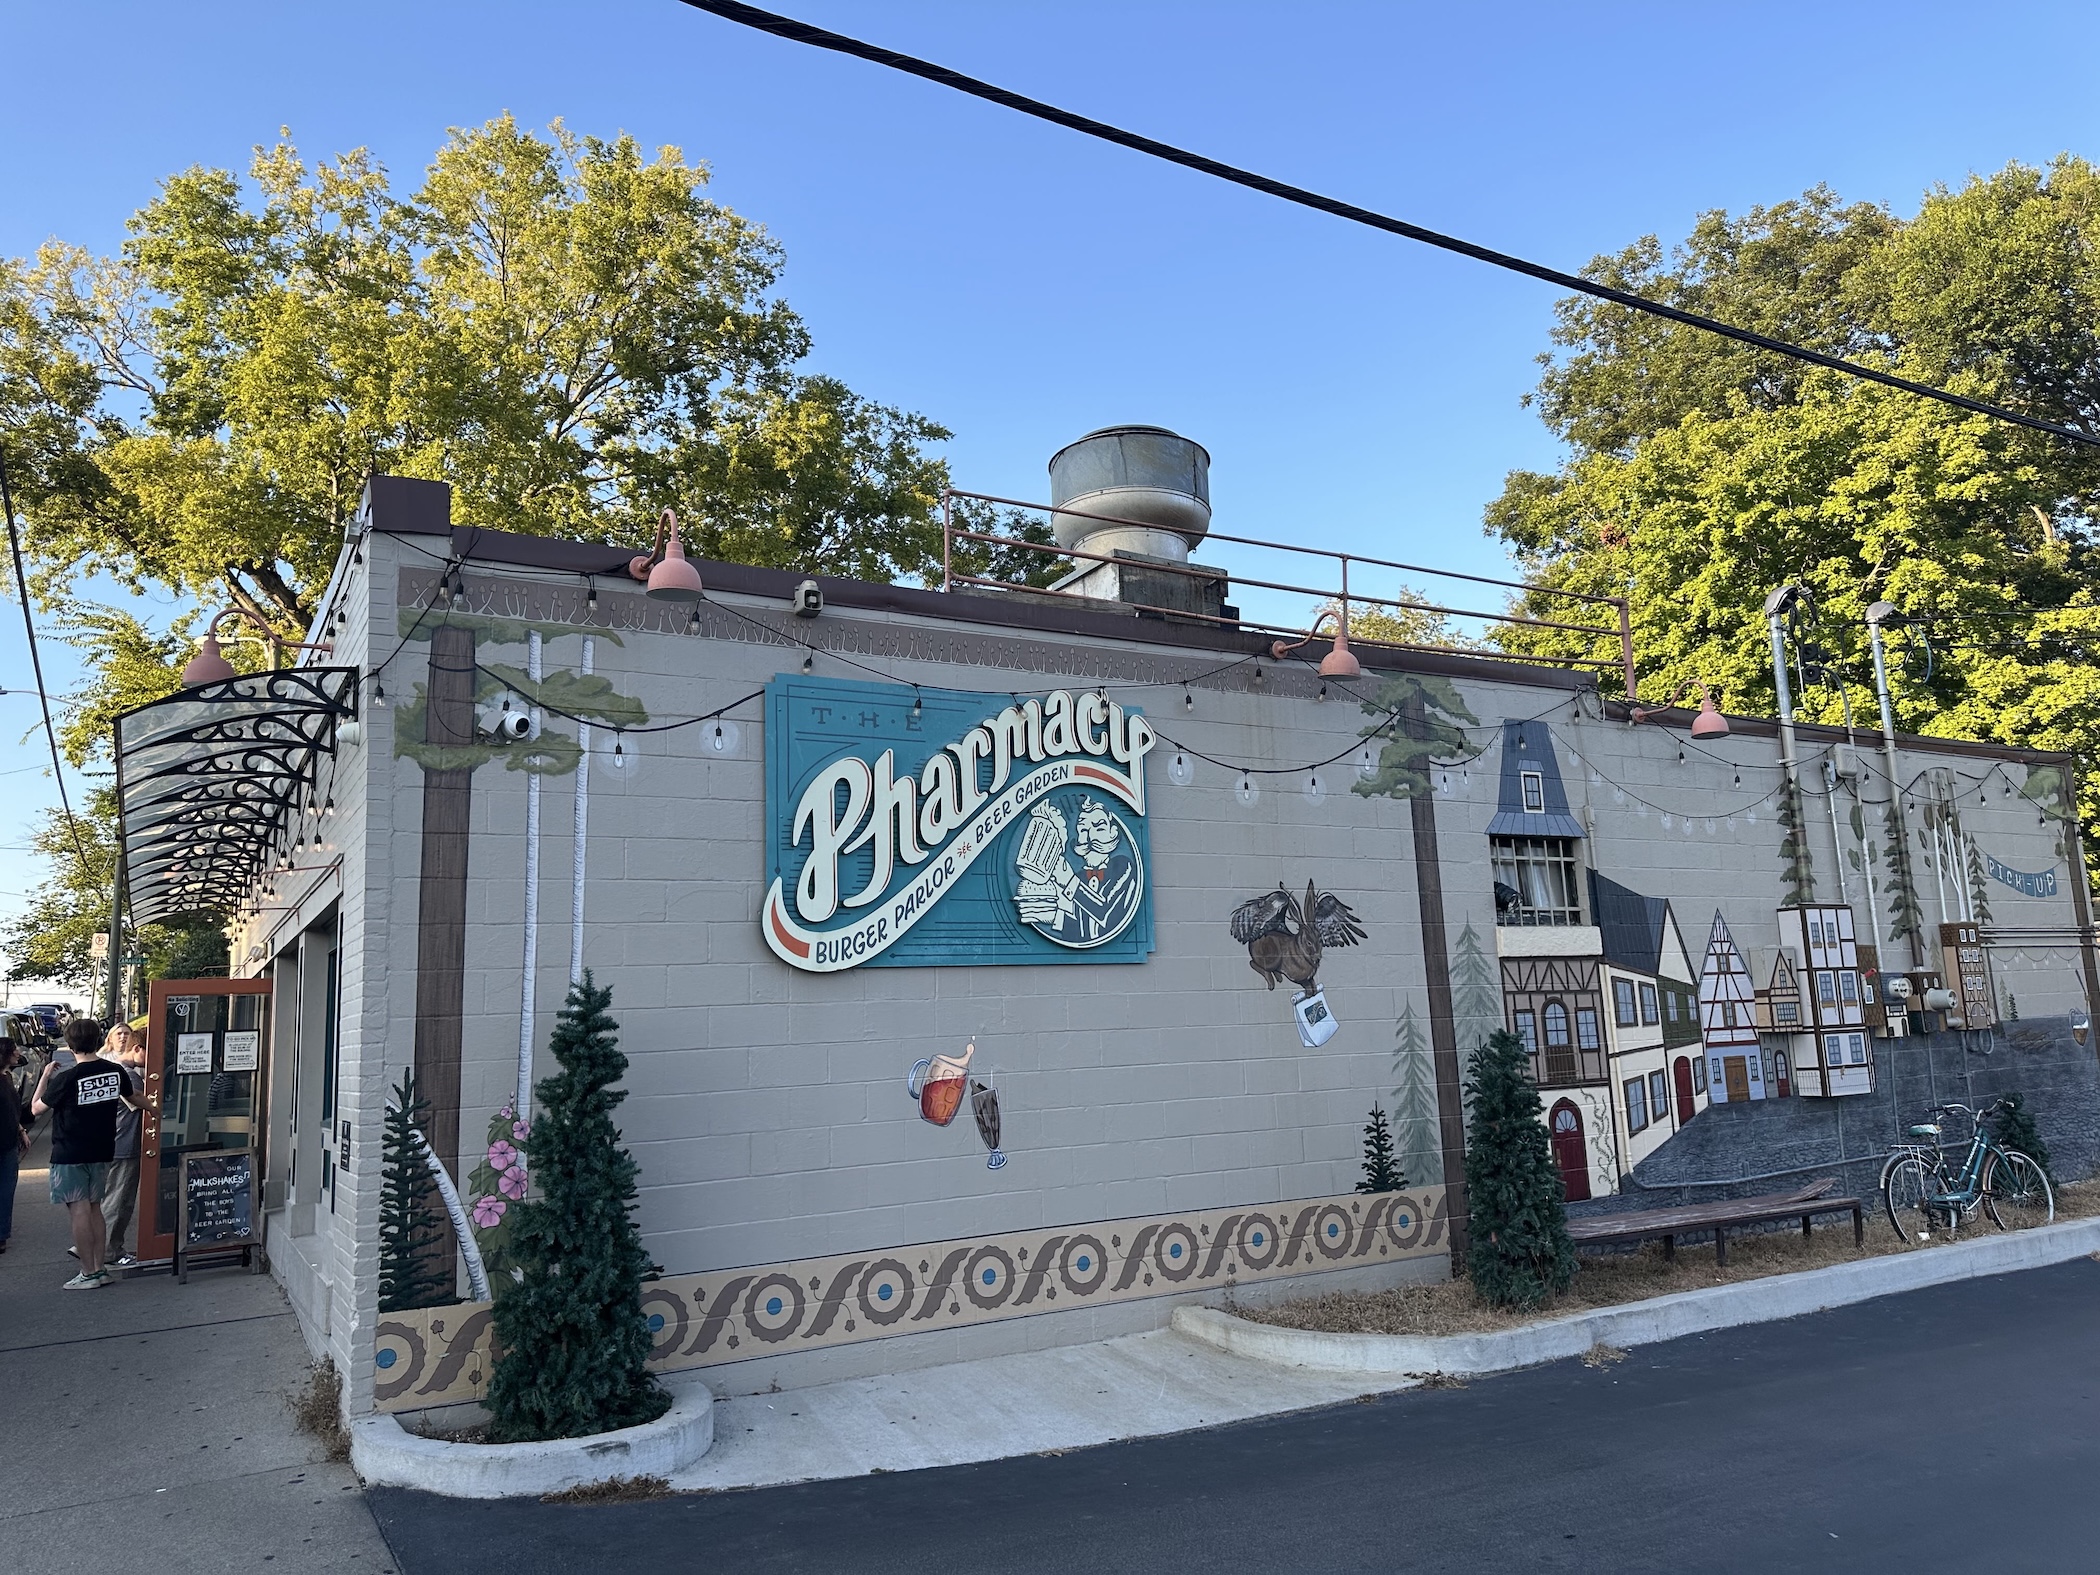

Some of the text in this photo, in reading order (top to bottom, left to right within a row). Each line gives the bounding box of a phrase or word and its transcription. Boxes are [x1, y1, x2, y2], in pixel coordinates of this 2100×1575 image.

[792, 689, 1157, 924] Pharmacy
[816, 917, 888, 964] BURGER
[894, 856, 956, 929] PARLOR
[975, 800, 1012, 844] BEER
[1015, 764, 1069, 804] GARDEN
[1988, 859, 2054, 893] PICK-UP
[193, 1174, 244, 1188] MILKSHAKES
[196, 1189, 218, 1197] BRING
[219, 1198, 235, 1206] BOYS
[217, 1208, 229, 1216] THE
[194, 1219, 213, 1228] BEER
